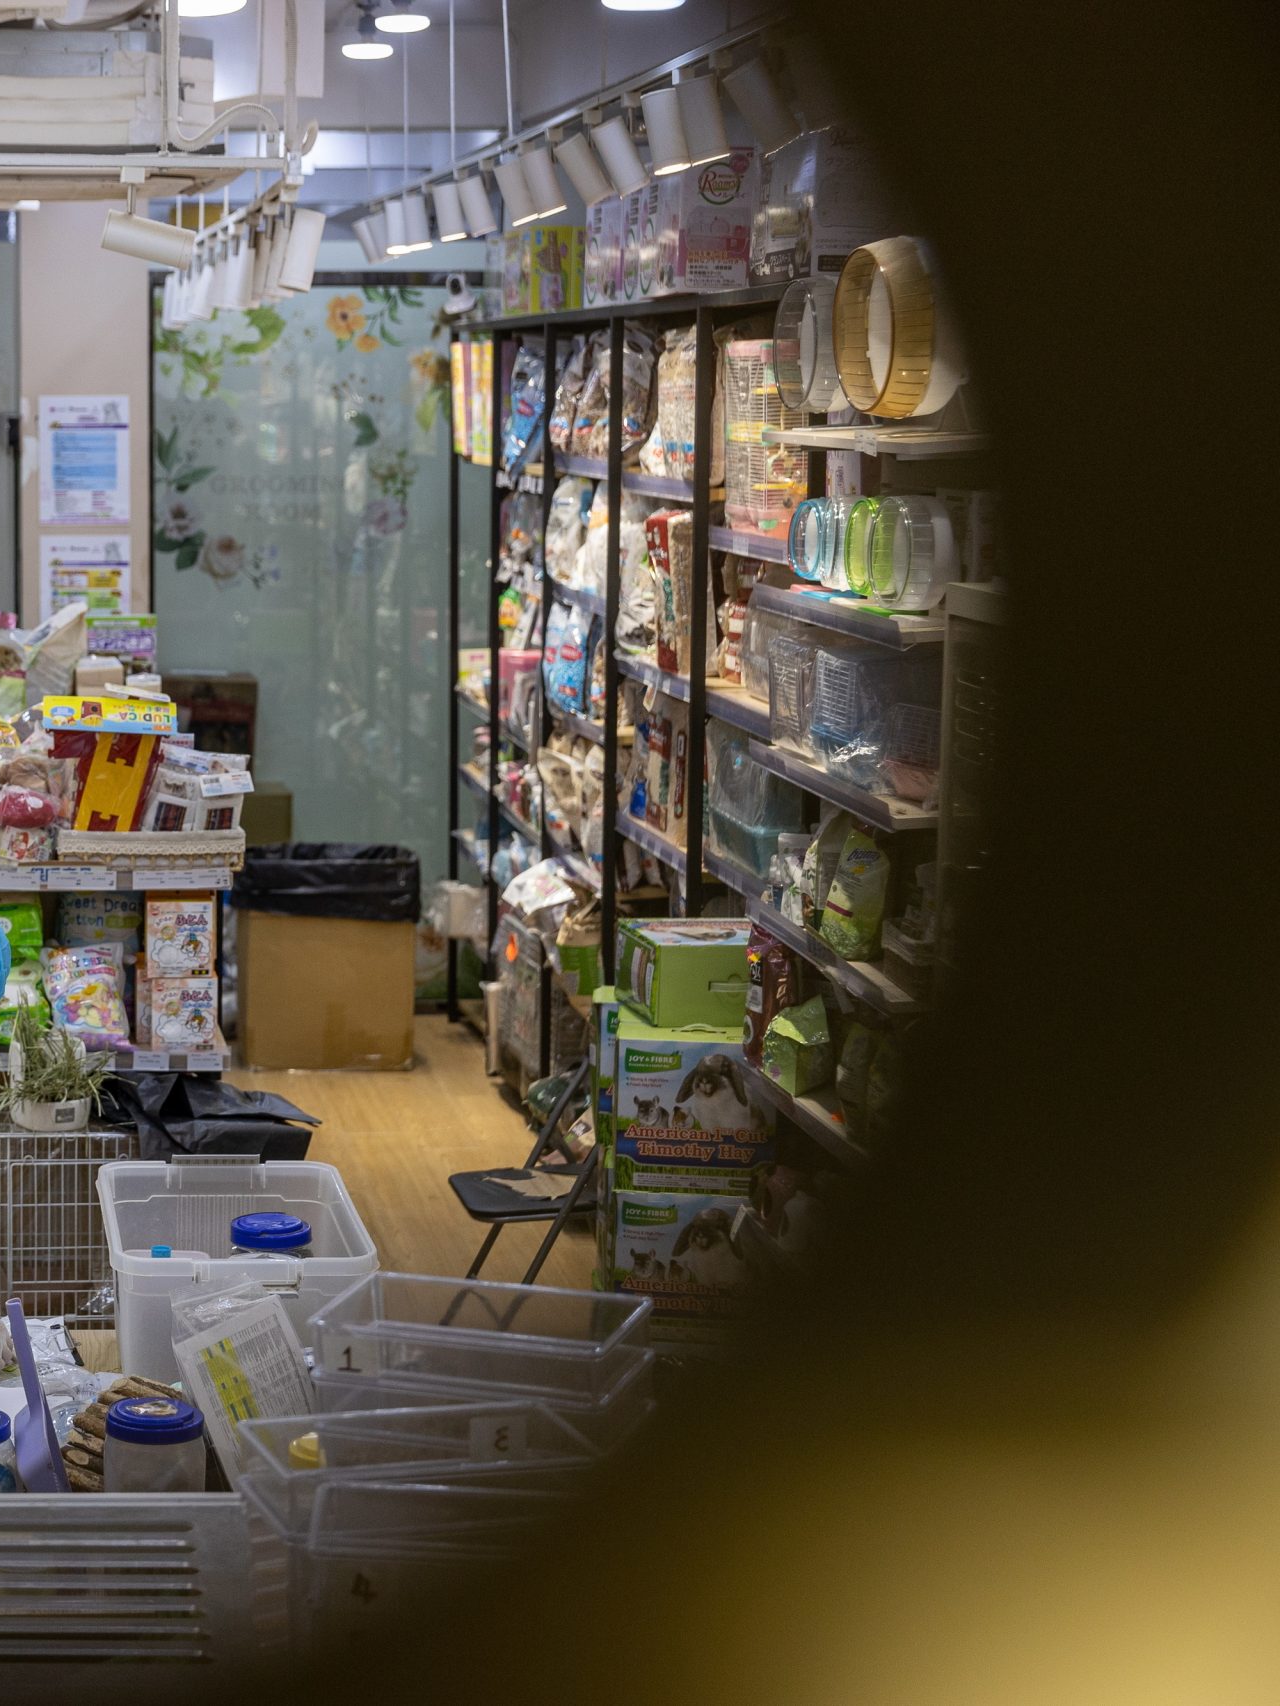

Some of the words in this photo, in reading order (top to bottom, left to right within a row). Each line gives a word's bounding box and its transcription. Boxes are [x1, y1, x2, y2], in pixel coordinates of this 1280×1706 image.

[119, 712, 171, 724] LUDICA
[175, 914, 208, 926] ふとん
[180, 990, 212, 1002] ふとん
[650, 1056, 674, 1064] FIBRE
[624, 1123, 711, 1141] American
[735, 1127, 768, 1144] Cut
[637, 1141, 715, 1161] Timothy
[718, 1144, 756, 1163] Hay
[647, 1209, 670, 1218] FIBRE
[621, 1275, 704, 1293] American
[337, 1346, 363, 1373] 1
